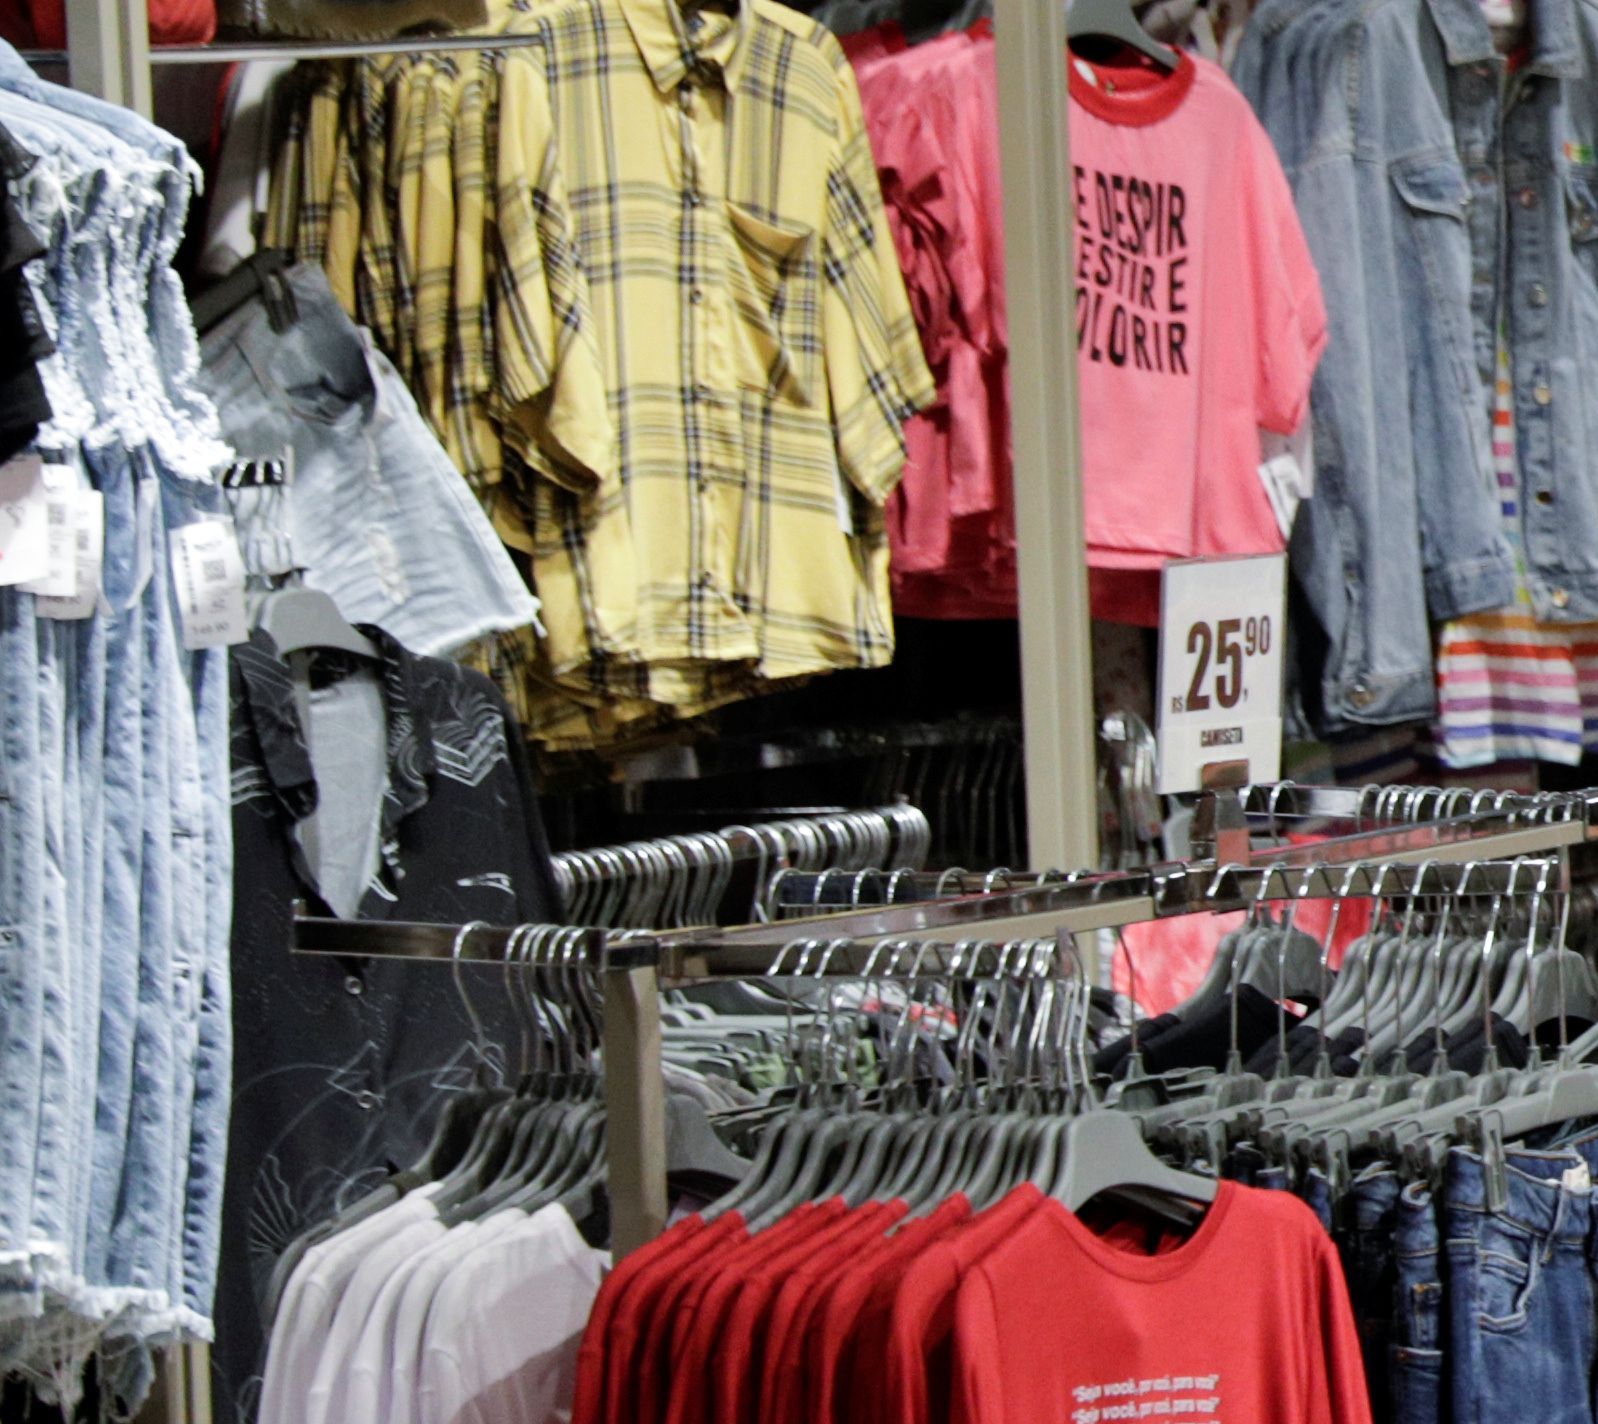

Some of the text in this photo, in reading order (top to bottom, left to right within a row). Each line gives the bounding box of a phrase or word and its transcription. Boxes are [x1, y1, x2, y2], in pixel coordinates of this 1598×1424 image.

[1095, 170, 1187, 258] DESPIR
[1077, 234, 1188, 314] ESTIR E
[1076, 286, 1189, 376] OLORIR
